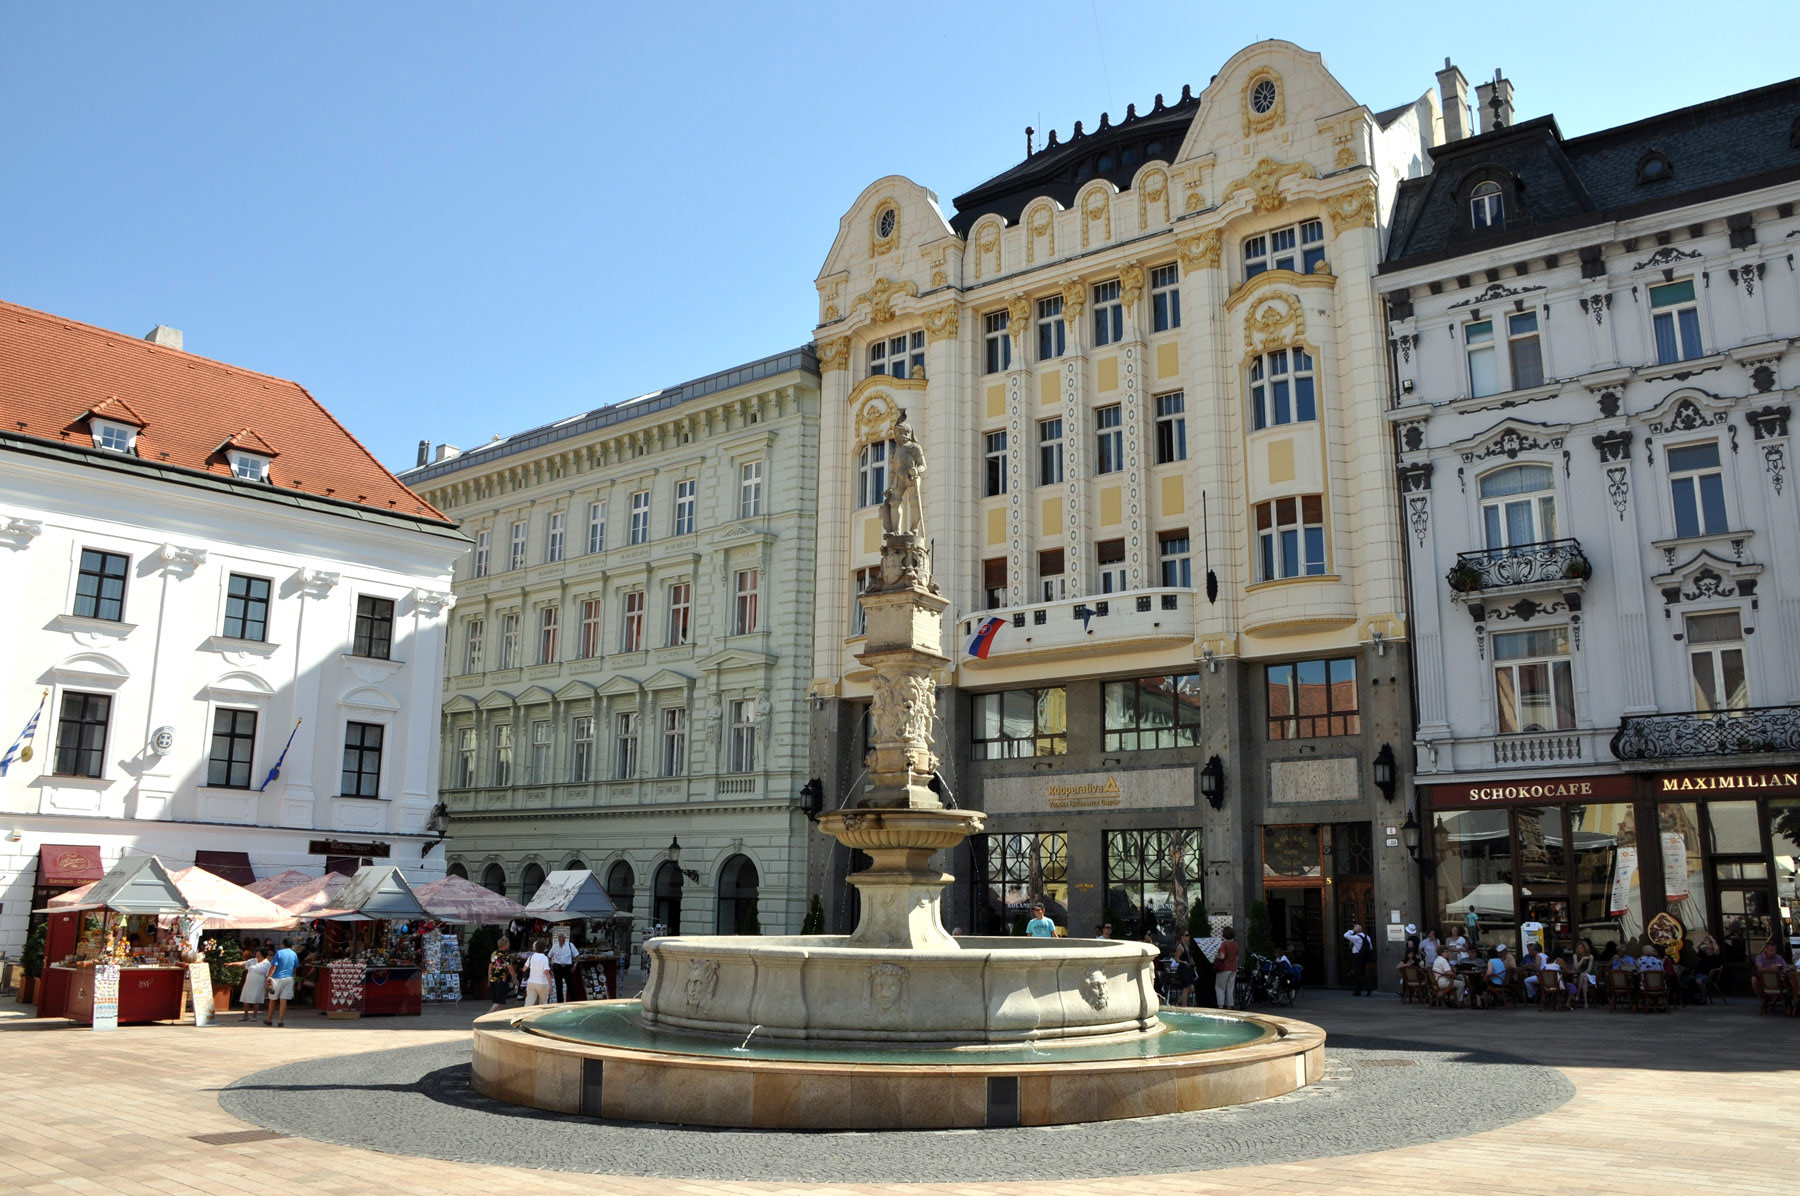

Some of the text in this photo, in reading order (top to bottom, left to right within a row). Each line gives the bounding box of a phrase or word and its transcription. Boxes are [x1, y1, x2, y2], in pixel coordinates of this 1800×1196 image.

[1047, 783, 1104, 797] Kooperativa
[1662, 773, 1798, 791] MAXIMILIAN
[1469, 782, 1592, 801] SCHOKOCAFE
[1326, 877, 1332, 885] 5
